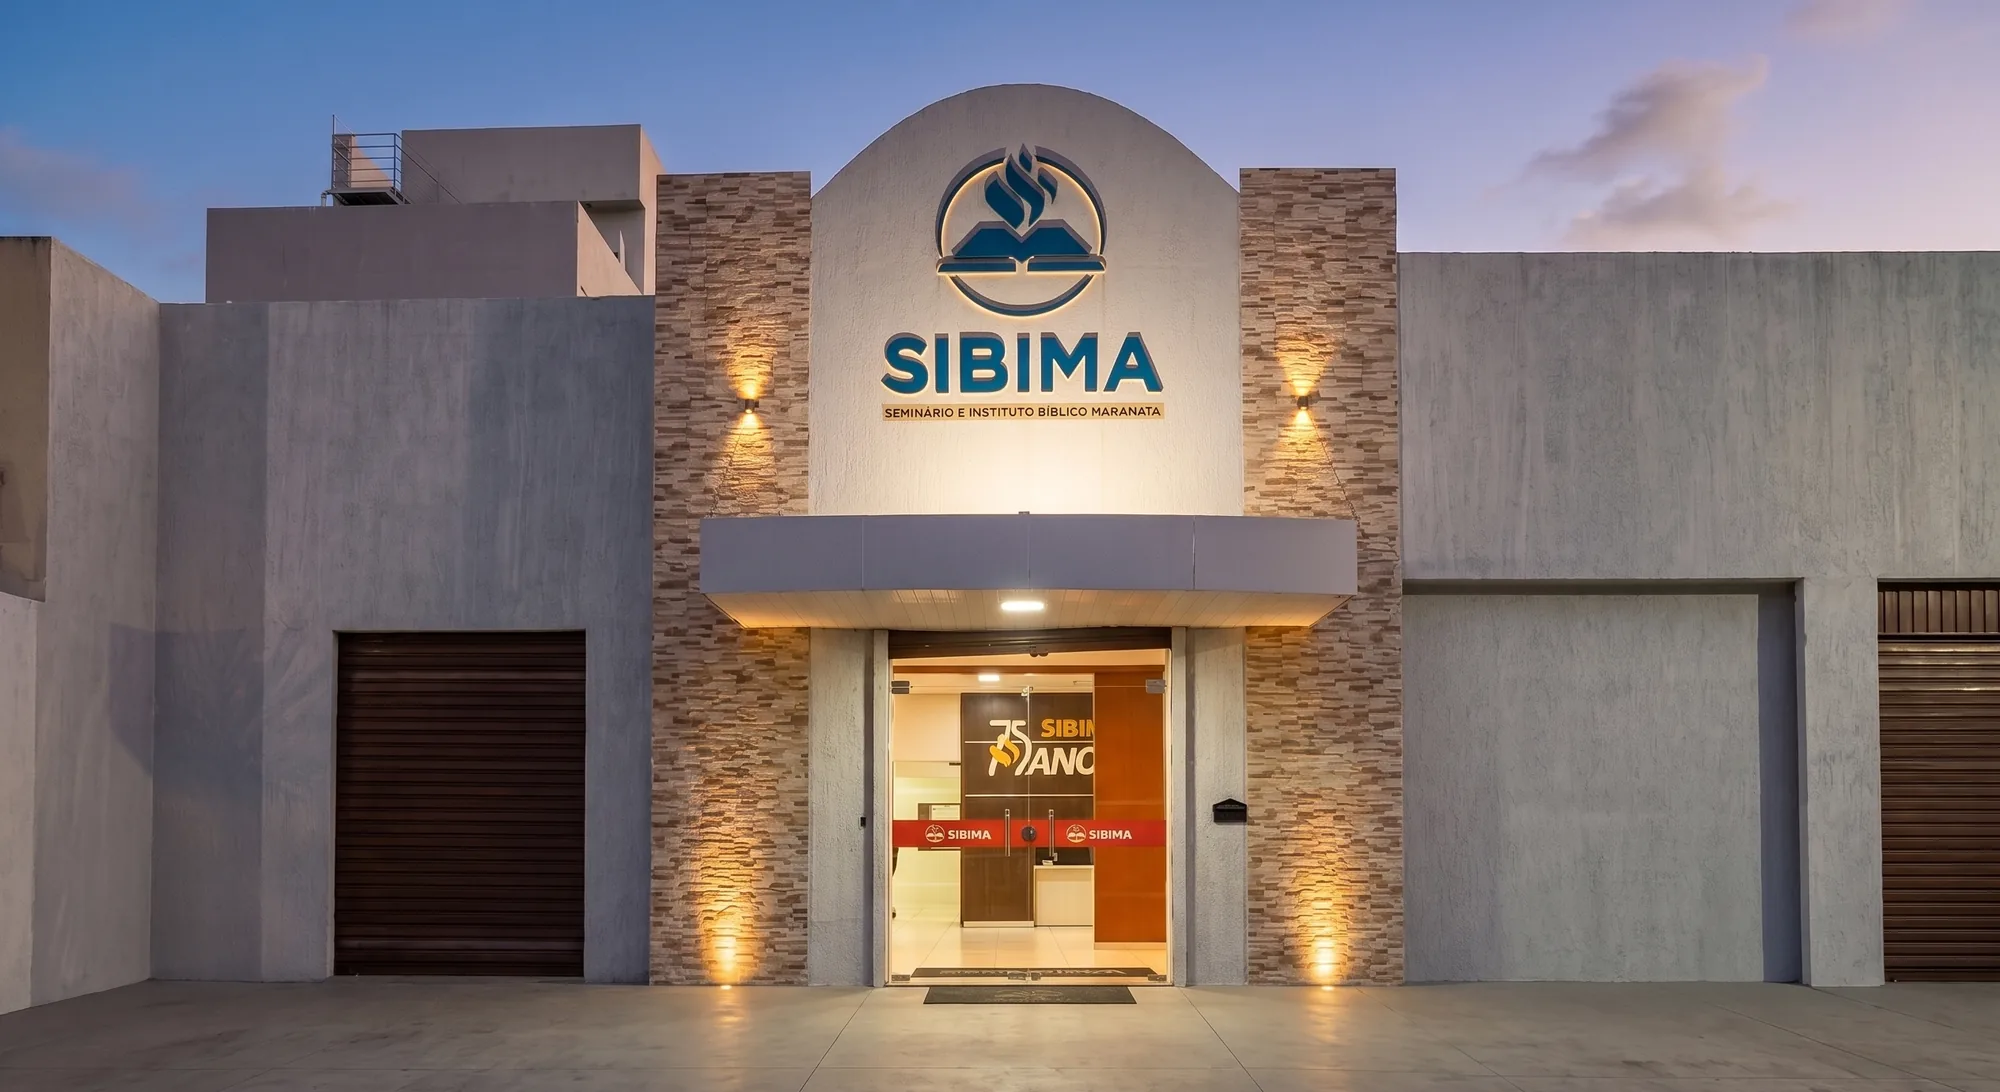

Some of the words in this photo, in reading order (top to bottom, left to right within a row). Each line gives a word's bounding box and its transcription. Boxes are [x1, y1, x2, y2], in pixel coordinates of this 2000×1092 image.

[881, 332, 1164, 394] SIBIMA
[884, 406, 954, 418] SEMINÁRIO
[958, 408, 965, 417] E
[969, 406, 1035, 417] INSTITUTO
[1038, 405, 1088, 417] BÍBLICO
[1092, 406, 1161, 417] MARANATA
[989, 719, 1033, 777] 75
[947, 829, 992, 840] SIBIMA
[1088, 829, 1133, 840] SIBIMA
